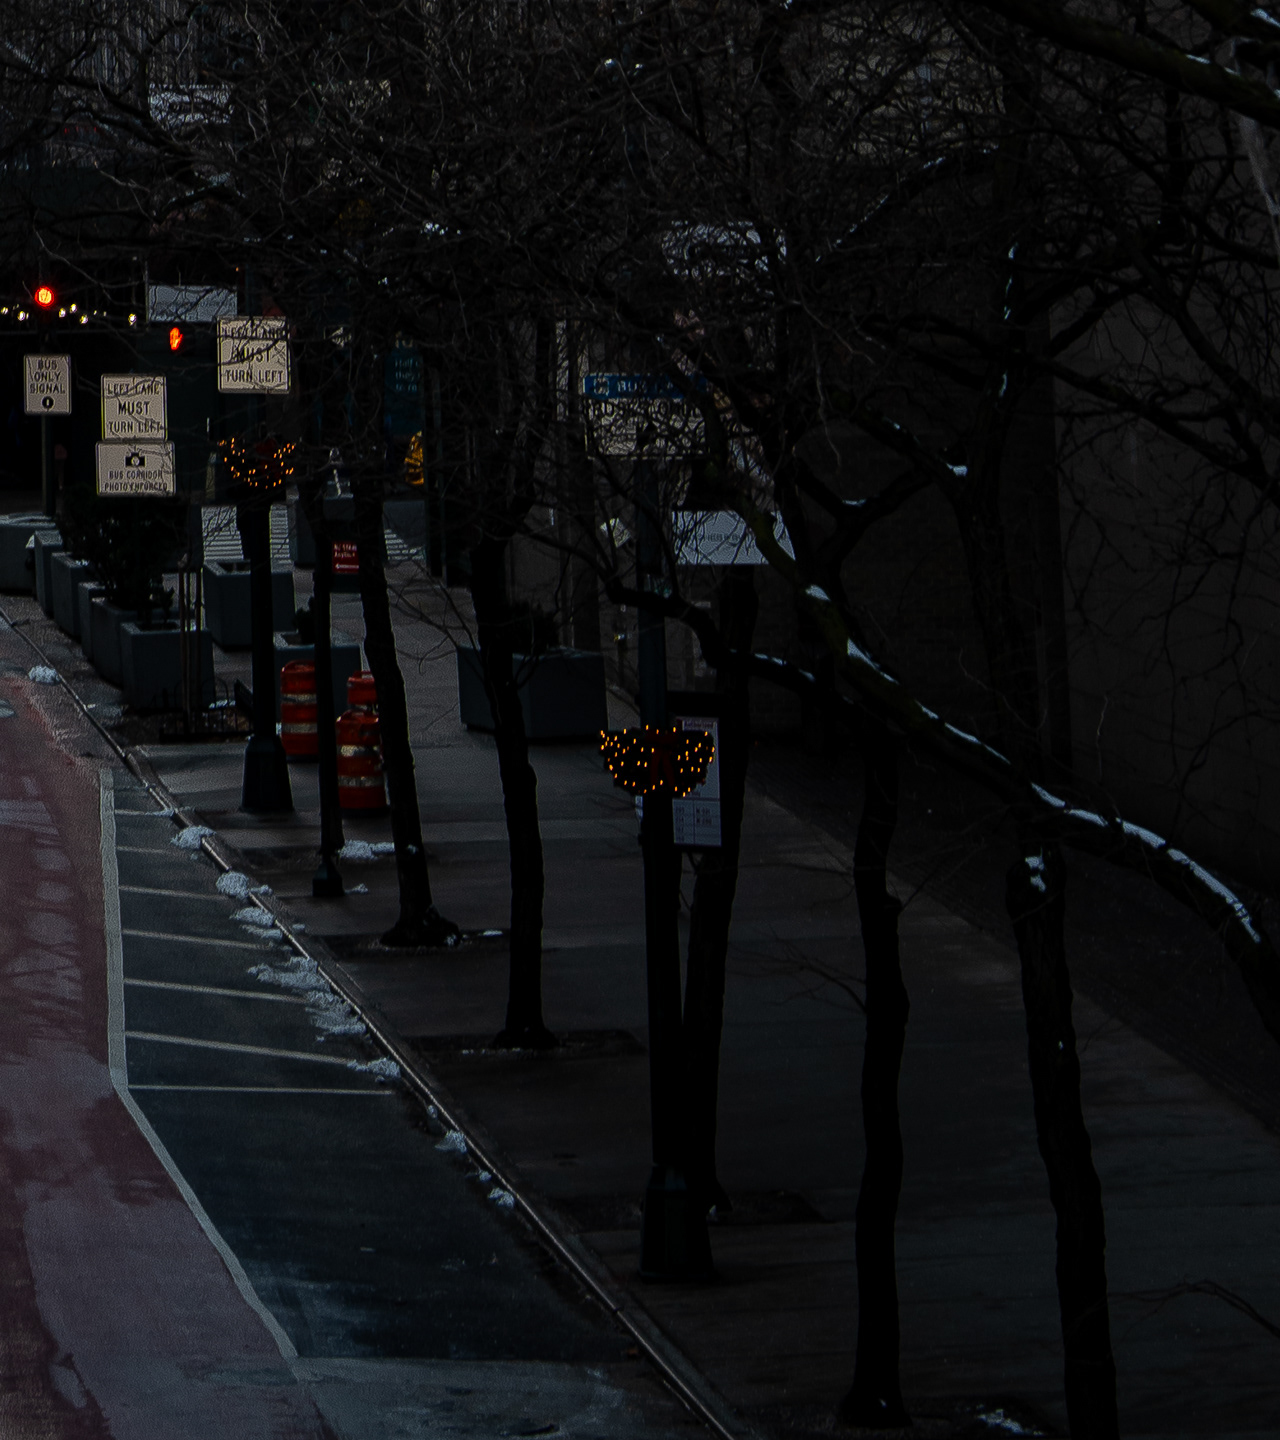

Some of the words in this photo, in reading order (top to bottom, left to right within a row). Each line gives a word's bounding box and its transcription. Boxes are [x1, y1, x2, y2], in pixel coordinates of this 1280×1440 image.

[236, 347, 270, 363] MUST
[37, 359, 58, 370] BUS
[33, 371, 62, 381] ONLY
[225, 369, 253, 383] TURN
[258, 369, 284, 383] LEFT
[29, 383, 66, 394] SIGNAL
[107, 383, 130, 395] LEFT
[135, 383, 161, 395] LANE
[118, 400, 151, 415] MUST
[108, 421, 134, 433] TURN
[138, 421, 161, 433] LEFT
[109, 470, 124, 480] BUS
[126, 470, 163, 480] CORRIDOR
[104, 482, 128, 492] PHOTO
[129, 482, 168, 492] ENFORCED
